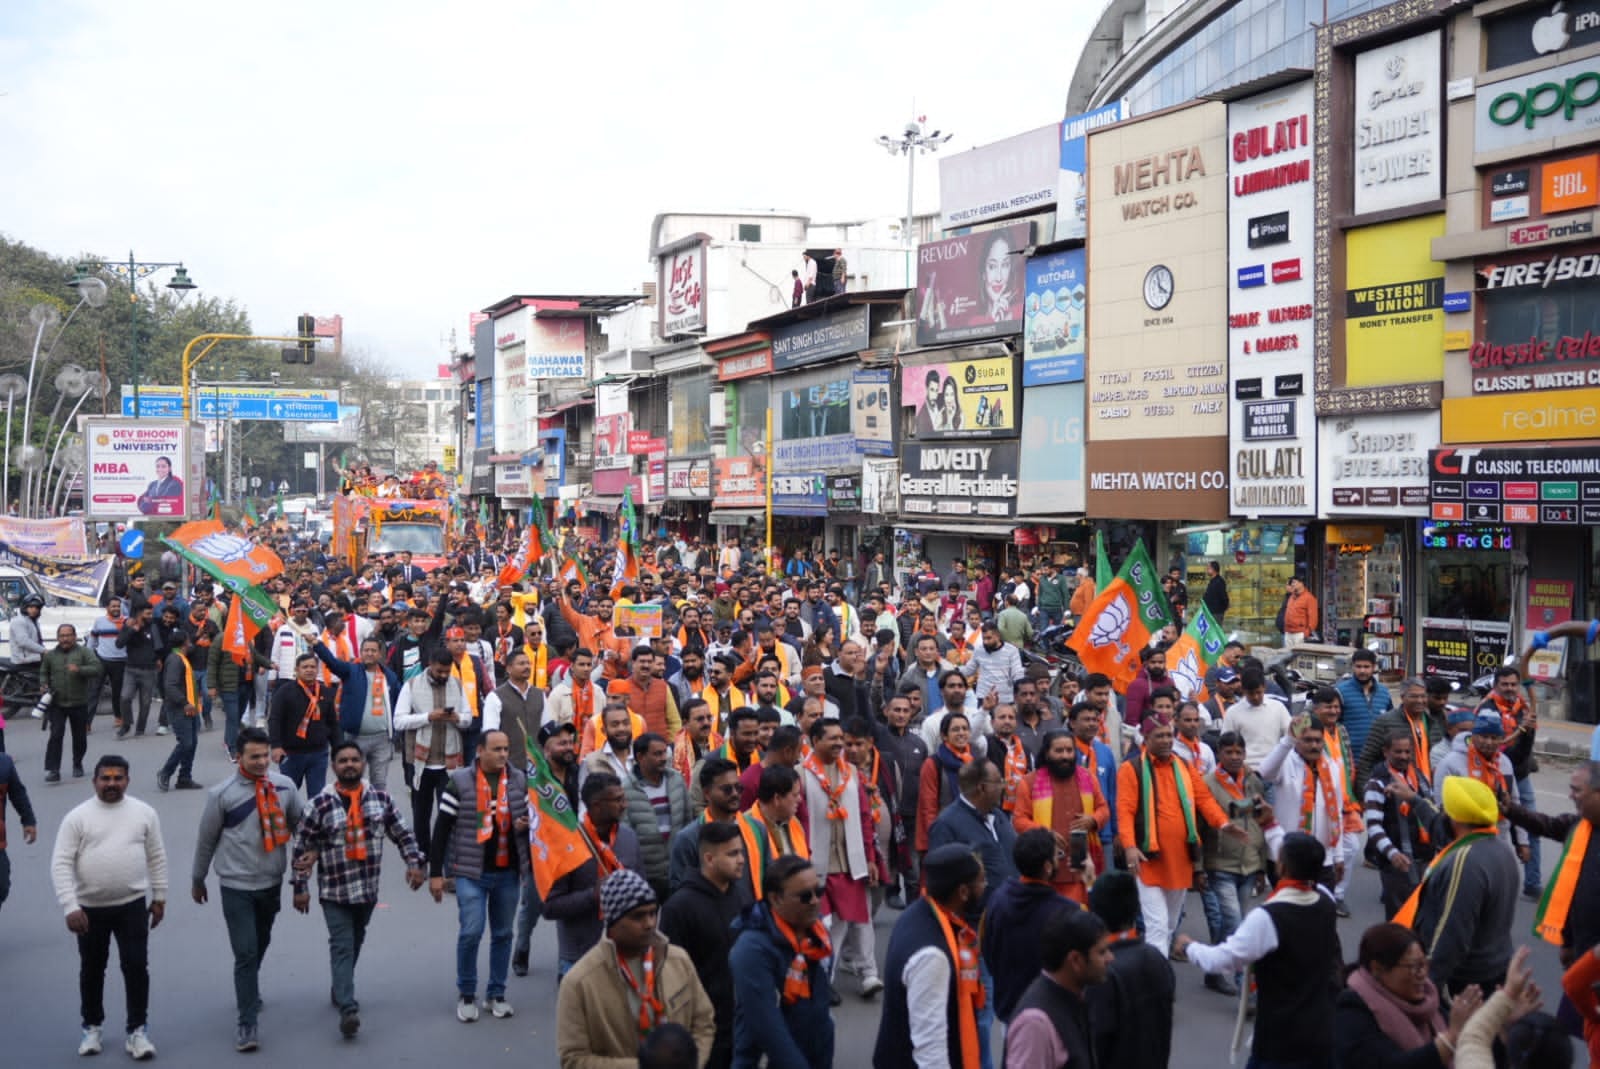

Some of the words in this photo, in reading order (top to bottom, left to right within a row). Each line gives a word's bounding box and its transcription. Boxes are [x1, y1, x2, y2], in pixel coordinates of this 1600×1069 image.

[1064, 108, 1117, 141] LUMINOUS
[1233, 114, 1308, 163] GULATI
[1114, 146, 1206, 196] MEHTA
[1234, 160, 1310, 197] LAMINATION
[1554, 171, 1587, 198] JBL
[950, 207, 978, 221] NOVELTY
[979, 201, 1009, 216] GENERAL
[1010, 189, 1052, 207] MERCHANTS
[1122, 195, 1169, 221] WATCH
[1174, 192, 1198, 210] CO.
[1261, 223, 1286, 236] iPhone
[1520, 221, 1592, 243] Portronics
[921, 240, 968, 264] REVLON
[1487, 262, 1545, 289] FIRE
[1355, 283, 1424, 303] WESTERN
[1375, 296, 1424, 312] UNION
[1359, 319, 1387, 328] MONEY
[1390, 314, 1433, 326] TRANSFER
[773, 337, 790, 354] SANT
[792, 331, 813, 350] SINGH
[814, 319, 865, 345] DISTRIBUTORS
[528, 356, 583, 365] MAHAWAR
[1469, 336, 1551, 368] Classic
[531, 367, 583, 376] OPTICALS
[977, 368, 1006, 378] SUGAR
[1474, 375, 1532, 392] CLASSIC
[1533, 371, 1585, 388] WATCH
[1099, 407, 1130, 419] CASIO
[1192, 401, 1223, 415] TIMEX
[1249, 403, 1290, 416] PREMIUM
[1503, 402, 1596, 433] realme
[113, 430, 134, 438] DEV
[137, 430, 178, 438] BHOOMI
[1053, 416, 1080, 444] LG
[1250, 424, 1288, 436] MOBILES
[113, 443, 177, 451] UNIVERSITY
[94, 463, 129, 474] MBA
[920, 448, 992, 471] NOVELTY
[1237, 448, 1304, 480] GULATI
[1434, 448, 1482, 475] CT
[1475, 460, 1523, 475] CLASSIC
[900, 473, 946, 495] General
[948, 473, 1017, 497] Merchants
[1091, 472, 1140, 490] MEHTA
[1142, 472, 1196, 490] WATCH
[1200, 471, 1229, 490] CO.
[1234, 485, 1307, 508] LAMINATION
[1423, 534, 1454, 548] Cash
[1457, 534, 1479, 548] For
[1481, 534, 1512, 549] Gold
[1426, 640, 1467, 650] WESTERN
[1438, 648, 1467, 657] UNION
